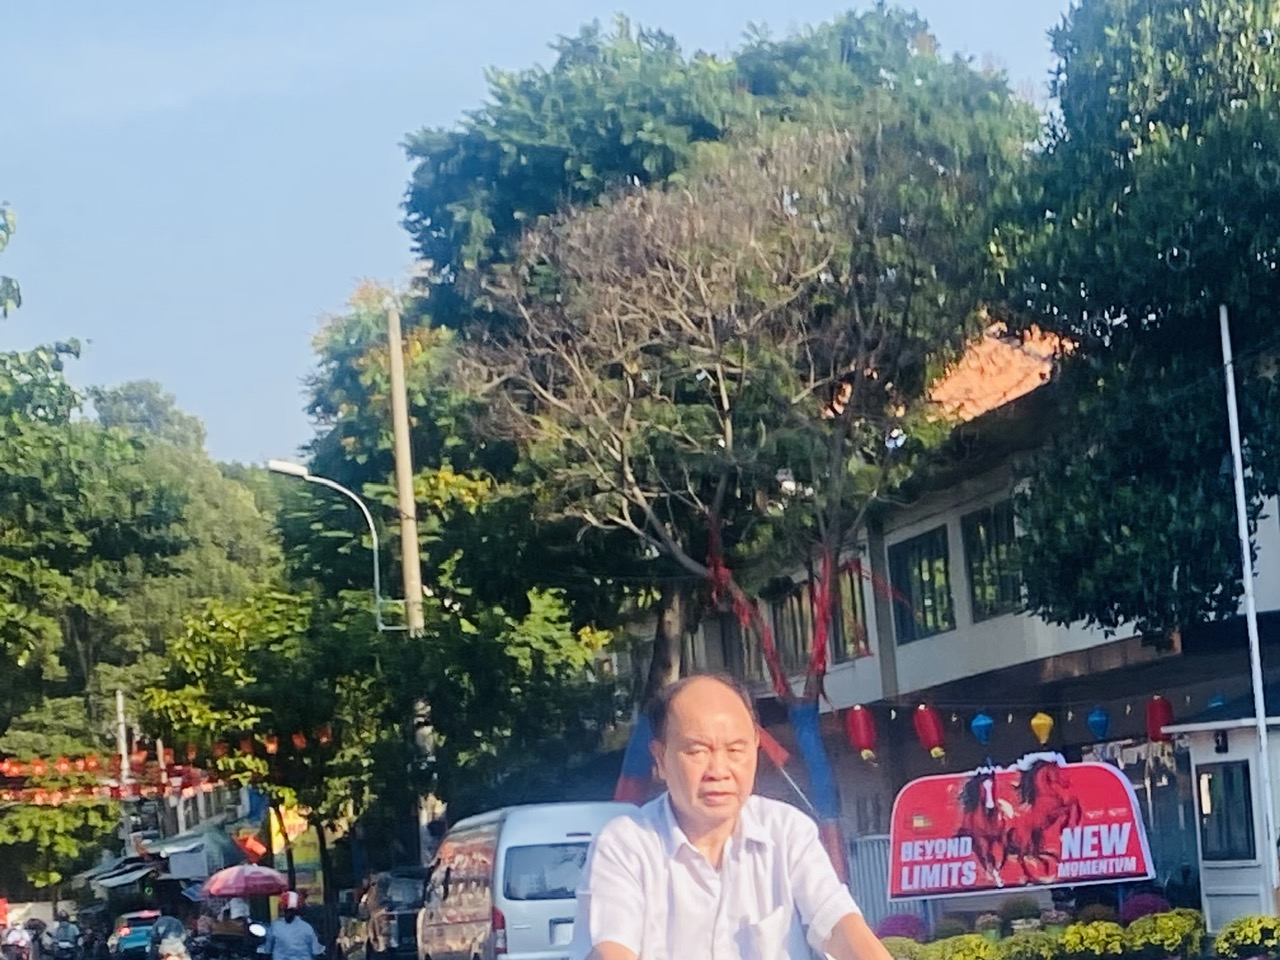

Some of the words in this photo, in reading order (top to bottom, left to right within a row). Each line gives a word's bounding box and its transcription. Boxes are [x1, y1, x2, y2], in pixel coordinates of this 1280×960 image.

[901, 837, 973, 862] BEYOND
[1061, 822, 1132, 860] NEW
[901, 860, 977, 890] LIMITS
